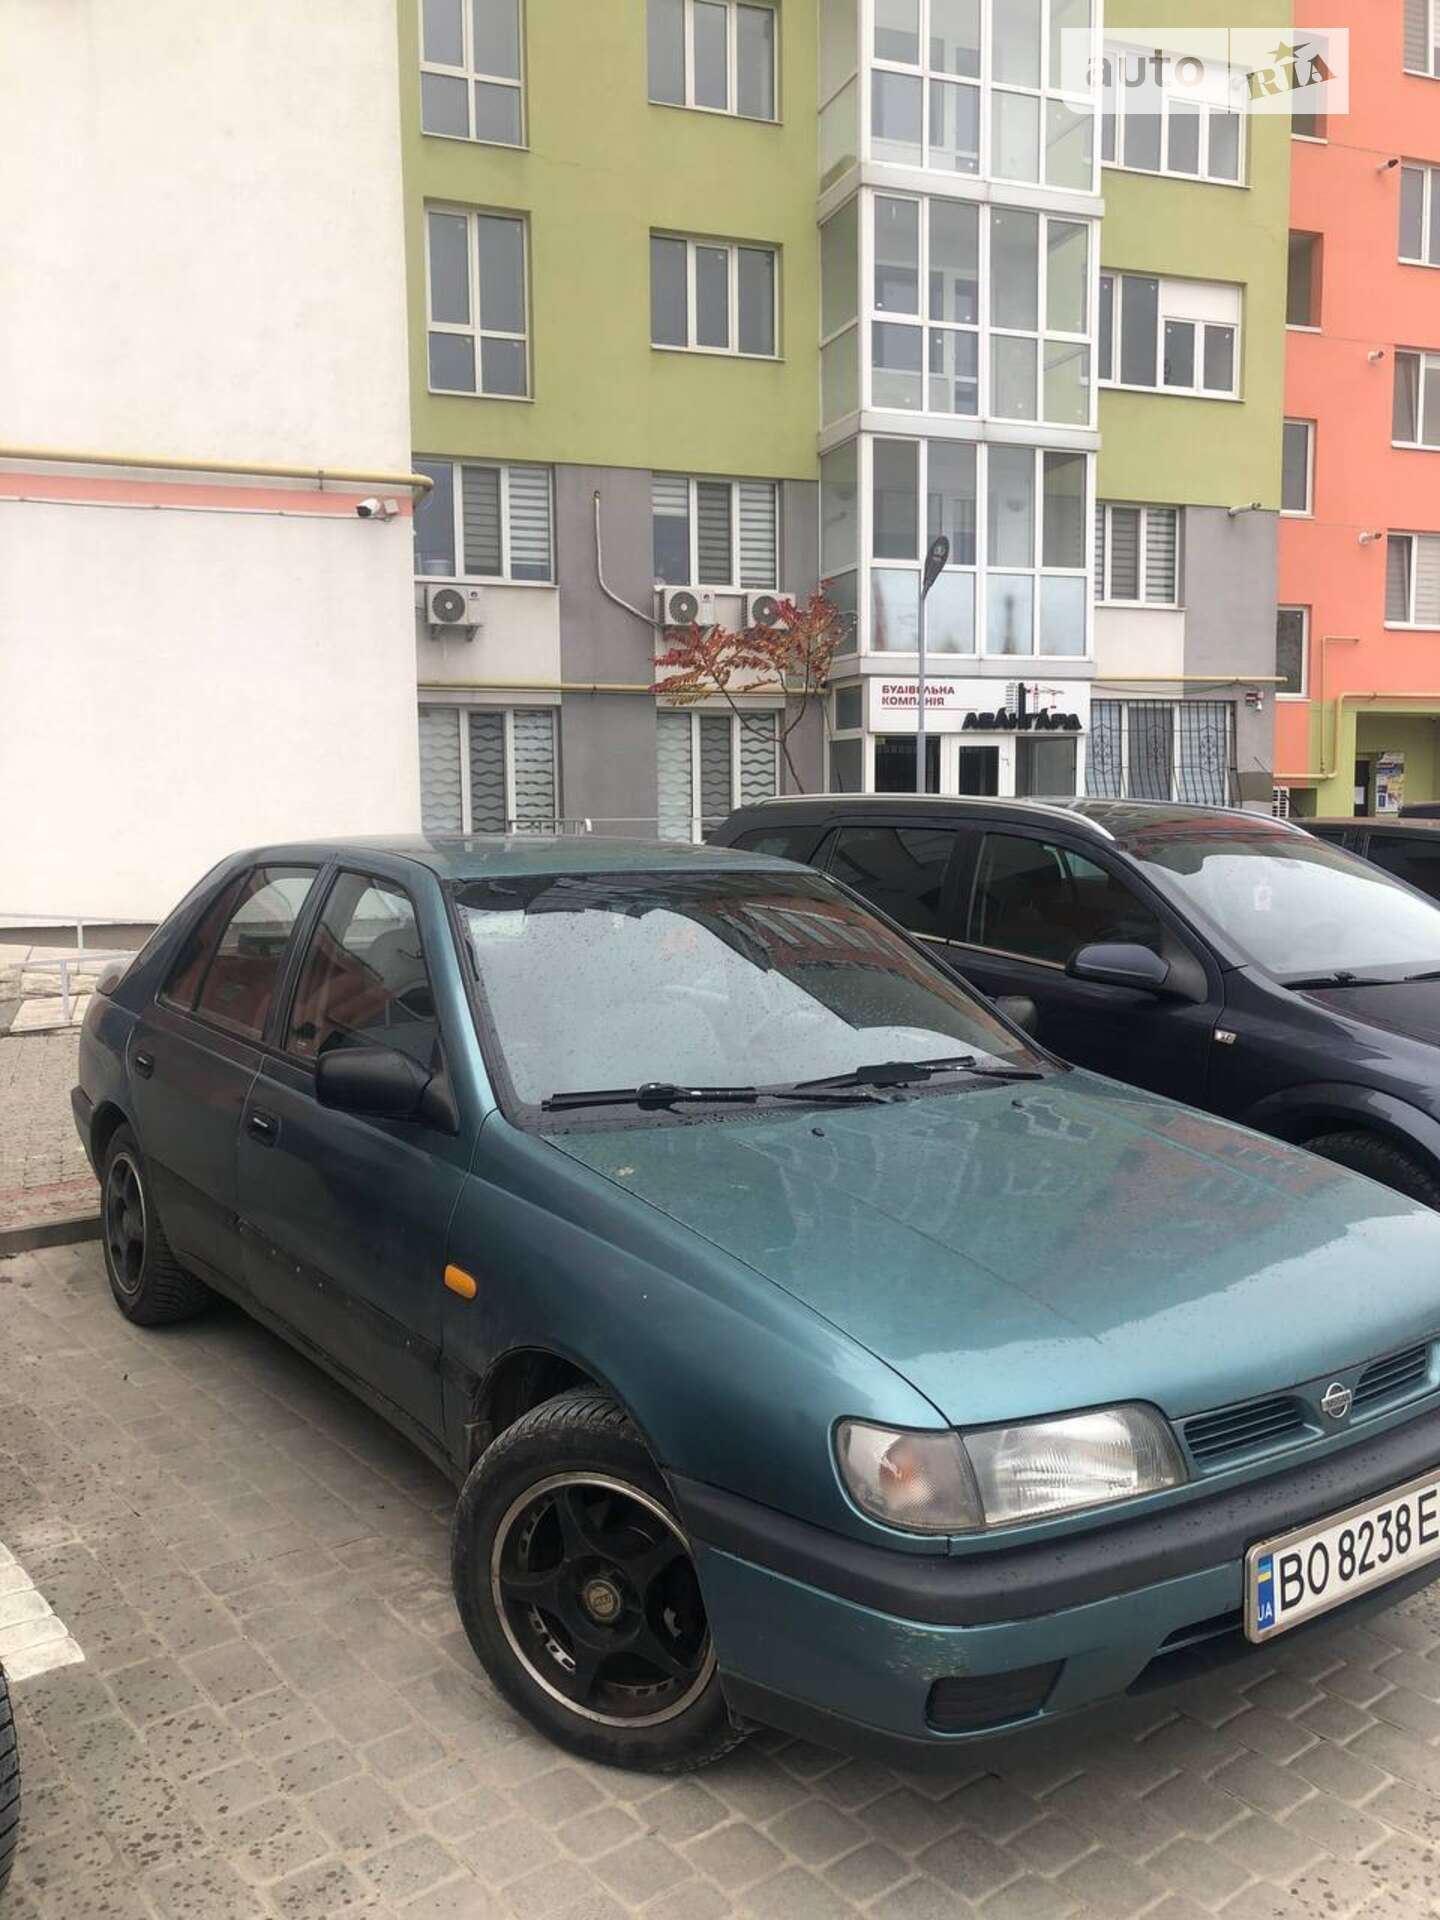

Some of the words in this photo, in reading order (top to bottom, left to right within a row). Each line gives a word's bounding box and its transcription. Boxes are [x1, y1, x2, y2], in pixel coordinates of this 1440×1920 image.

[881, 696, 945, 706] КОМПНІЯ
[1280, 1541, 1331, 1612] BO
[1338, 1503, 1412, 1582] 8238
[1257, 1601, 1273, 1621] UA
